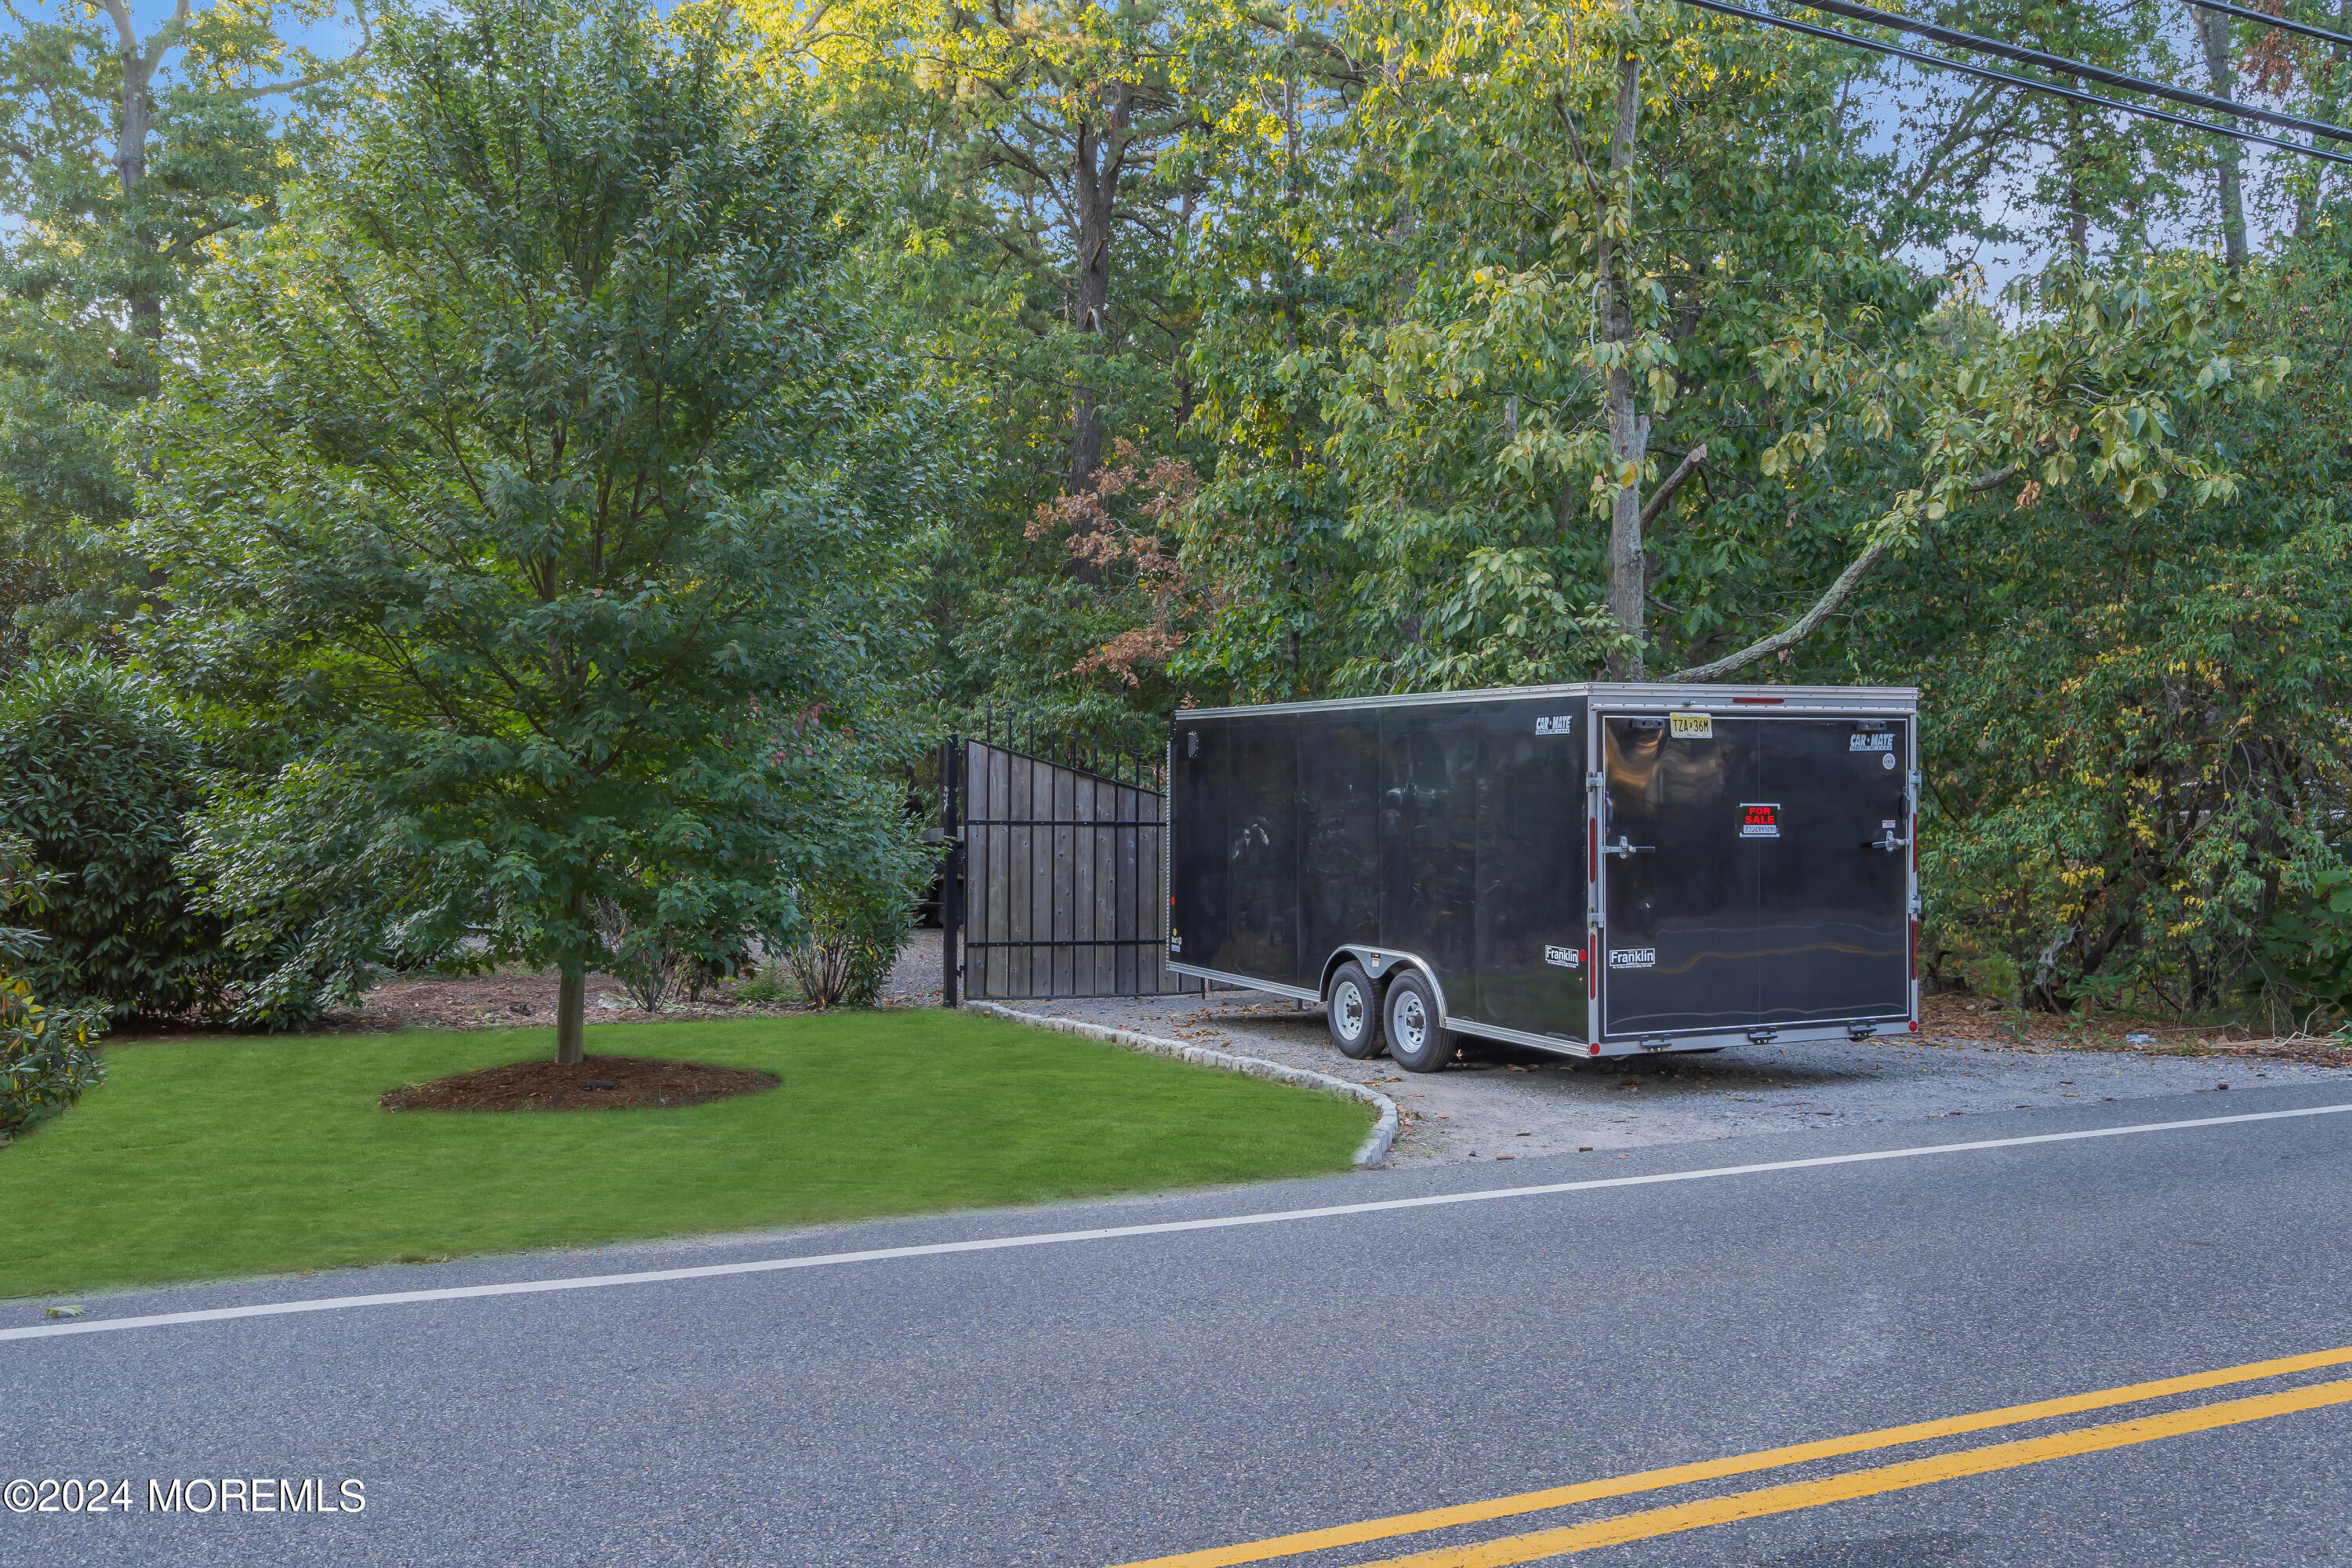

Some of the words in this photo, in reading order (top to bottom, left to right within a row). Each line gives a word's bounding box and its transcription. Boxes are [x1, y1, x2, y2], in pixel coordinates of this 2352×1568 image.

[1673, 719, 1689, 732] TZA
[1749, 807, 1771, 815] FOR
[1744, 815, 1775, 825] SALE
[1547, 946, 1577, 963] Franklin
[1611, 950, 1653, 964] Franklin
